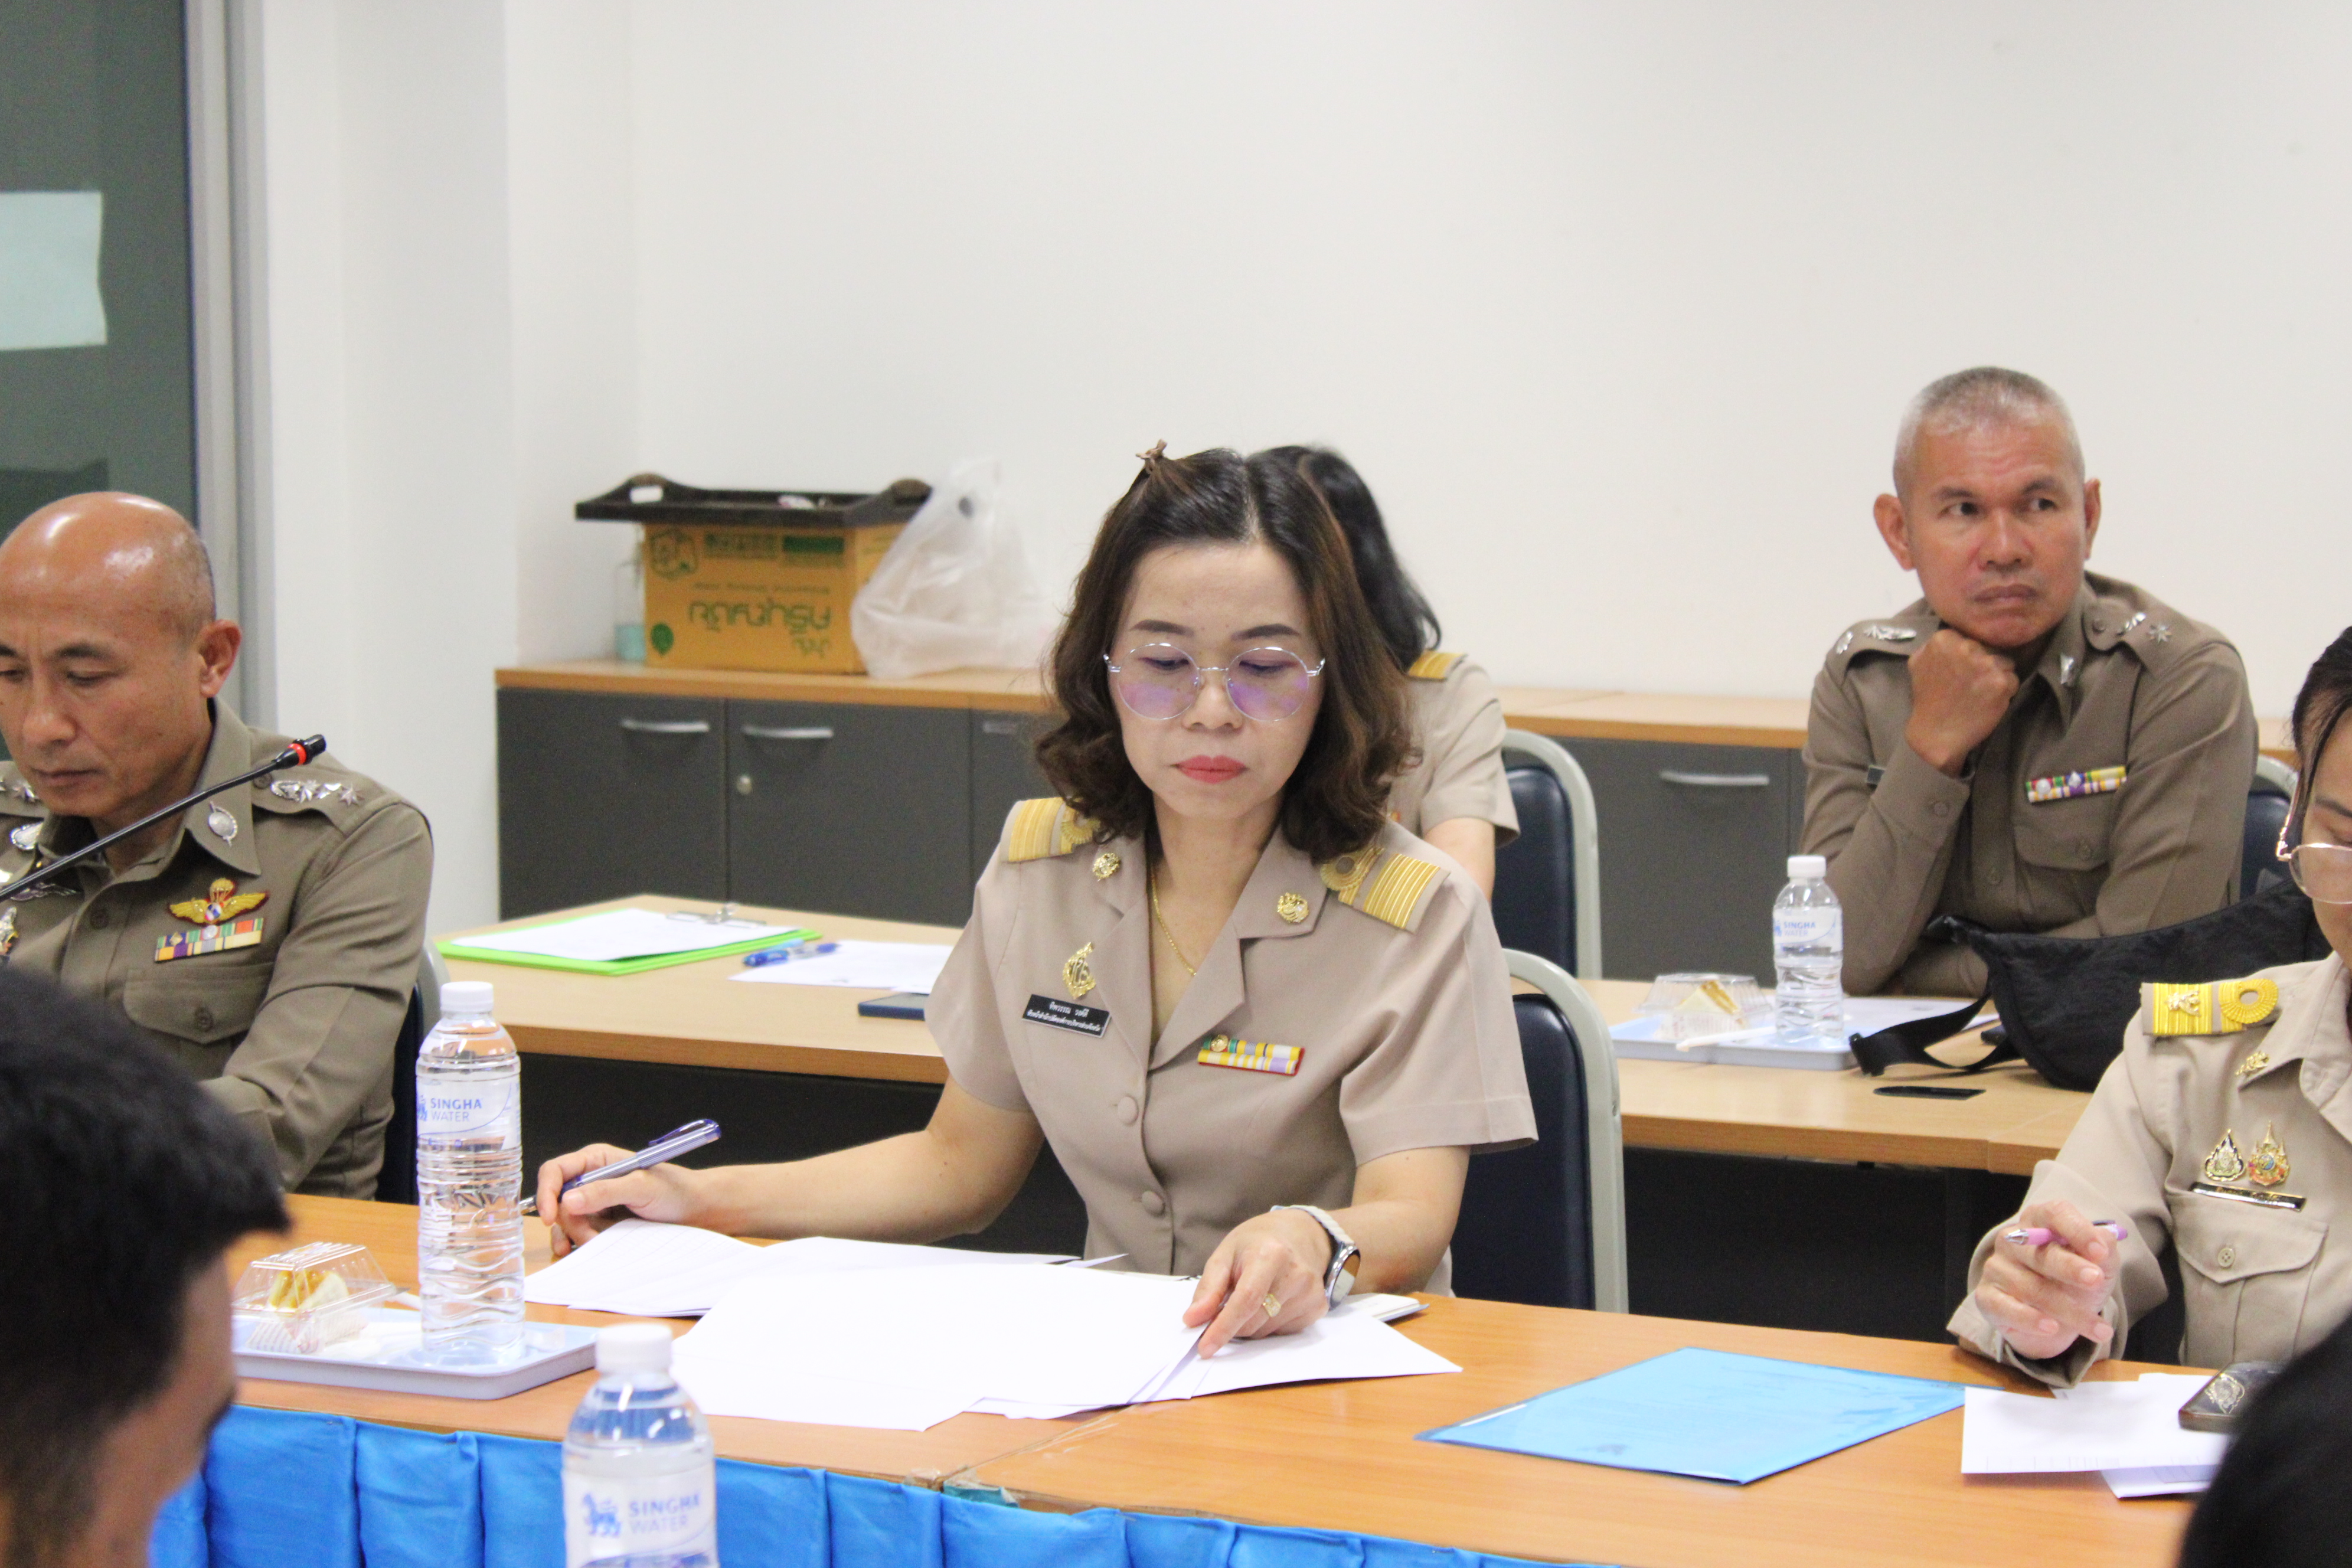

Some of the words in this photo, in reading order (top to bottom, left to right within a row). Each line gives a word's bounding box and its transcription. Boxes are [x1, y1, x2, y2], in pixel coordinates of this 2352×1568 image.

[430, 1097, 482, 1110] SINGHA
[431, 1111, 470, 1122] WATER
[629, 1493, 700, 1517] SINGHA
[629, 1513, 688, 1534] WATER
